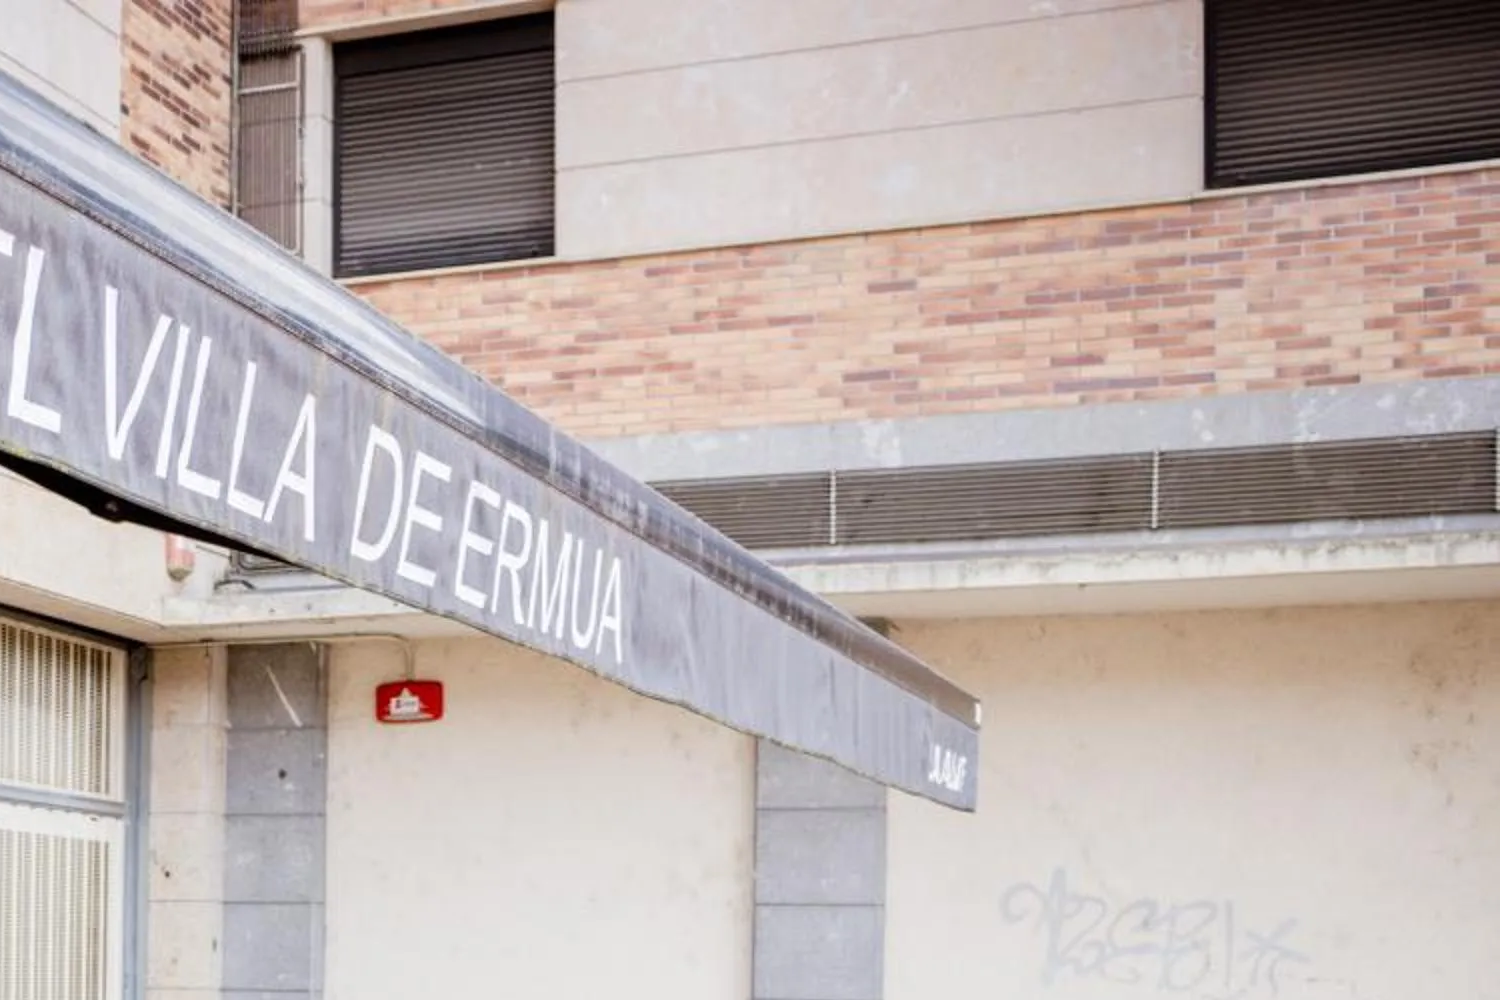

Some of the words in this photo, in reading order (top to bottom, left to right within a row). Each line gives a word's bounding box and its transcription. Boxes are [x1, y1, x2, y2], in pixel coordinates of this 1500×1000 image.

[105, 285, 316, 543] VILLA
[350, 424, 452, 588] DE
[454, 480, 623, 665] ERMUA
